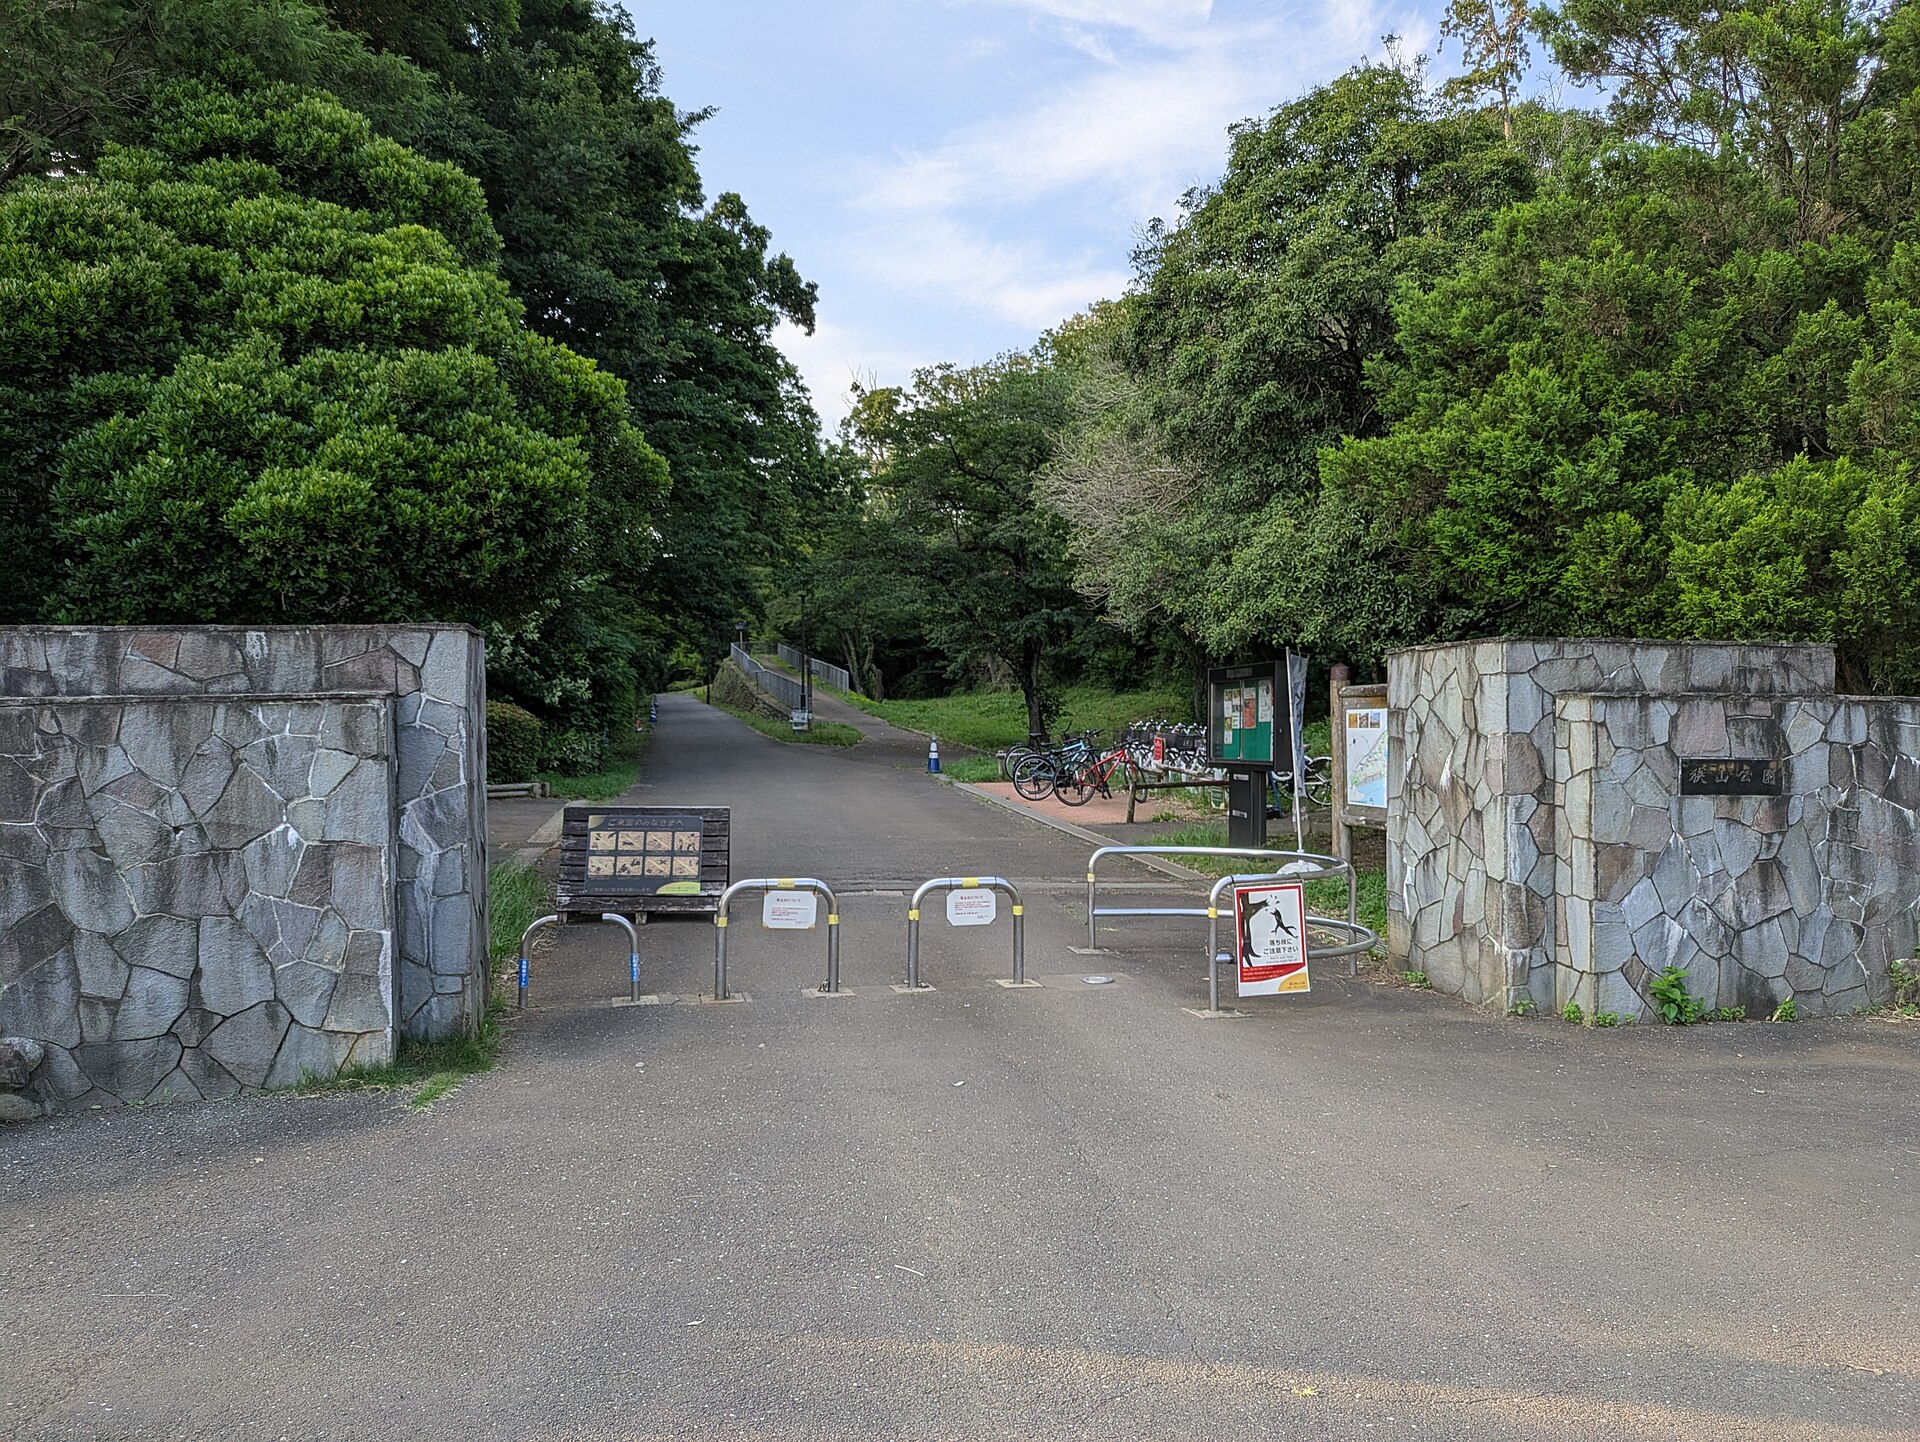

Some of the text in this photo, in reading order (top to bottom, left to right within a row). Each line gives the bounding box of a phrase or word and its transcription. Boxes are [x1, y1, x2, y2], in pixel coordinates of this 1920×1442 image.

[1263, 946, 1299, 954] ご注意下さい
